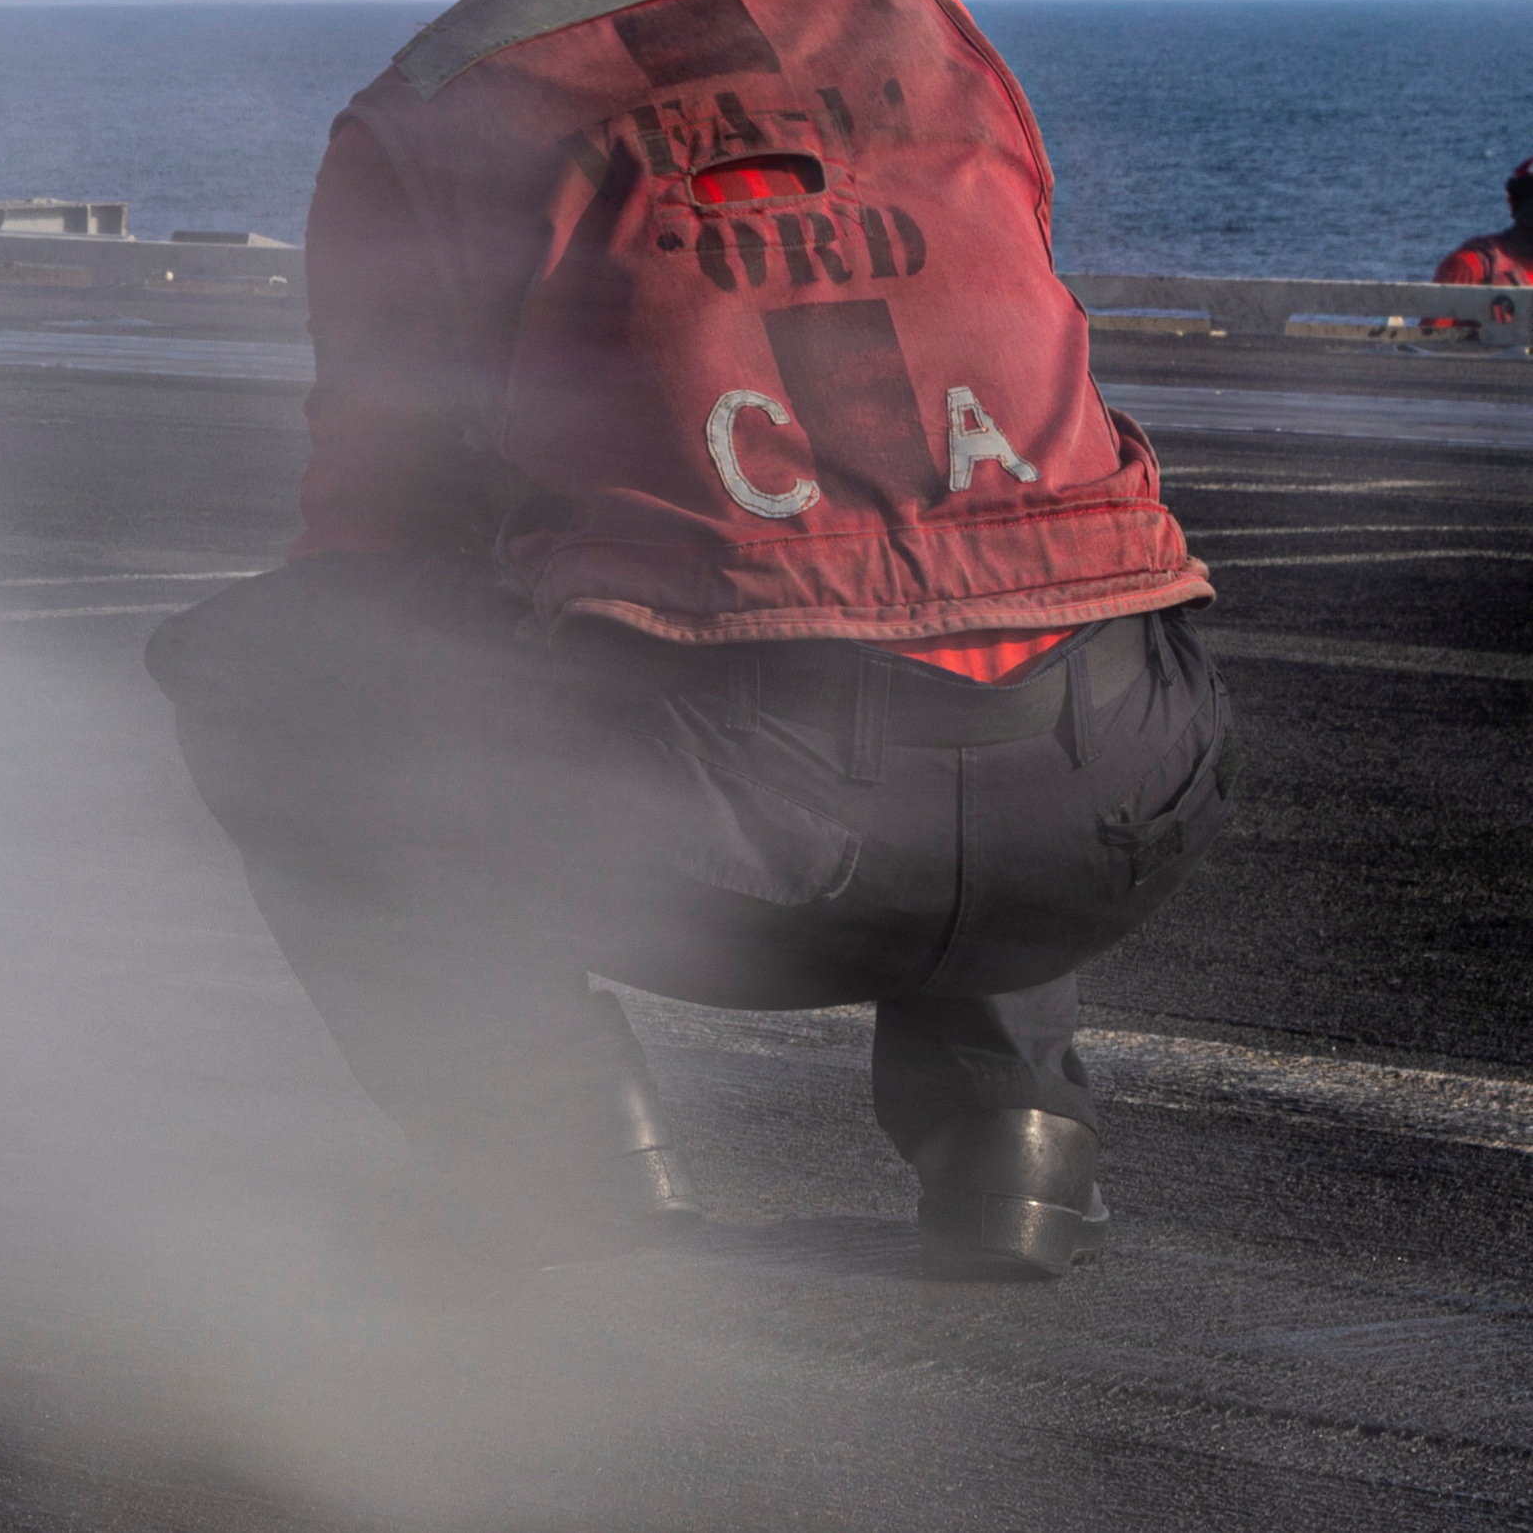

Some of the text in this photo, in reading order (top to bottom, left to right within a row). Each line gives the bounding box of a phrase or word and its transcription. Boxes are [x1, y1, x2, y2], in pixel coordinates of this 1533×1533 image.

[695, 205, 927, 293] ORD
[706, 386, 1042, 518] C A
